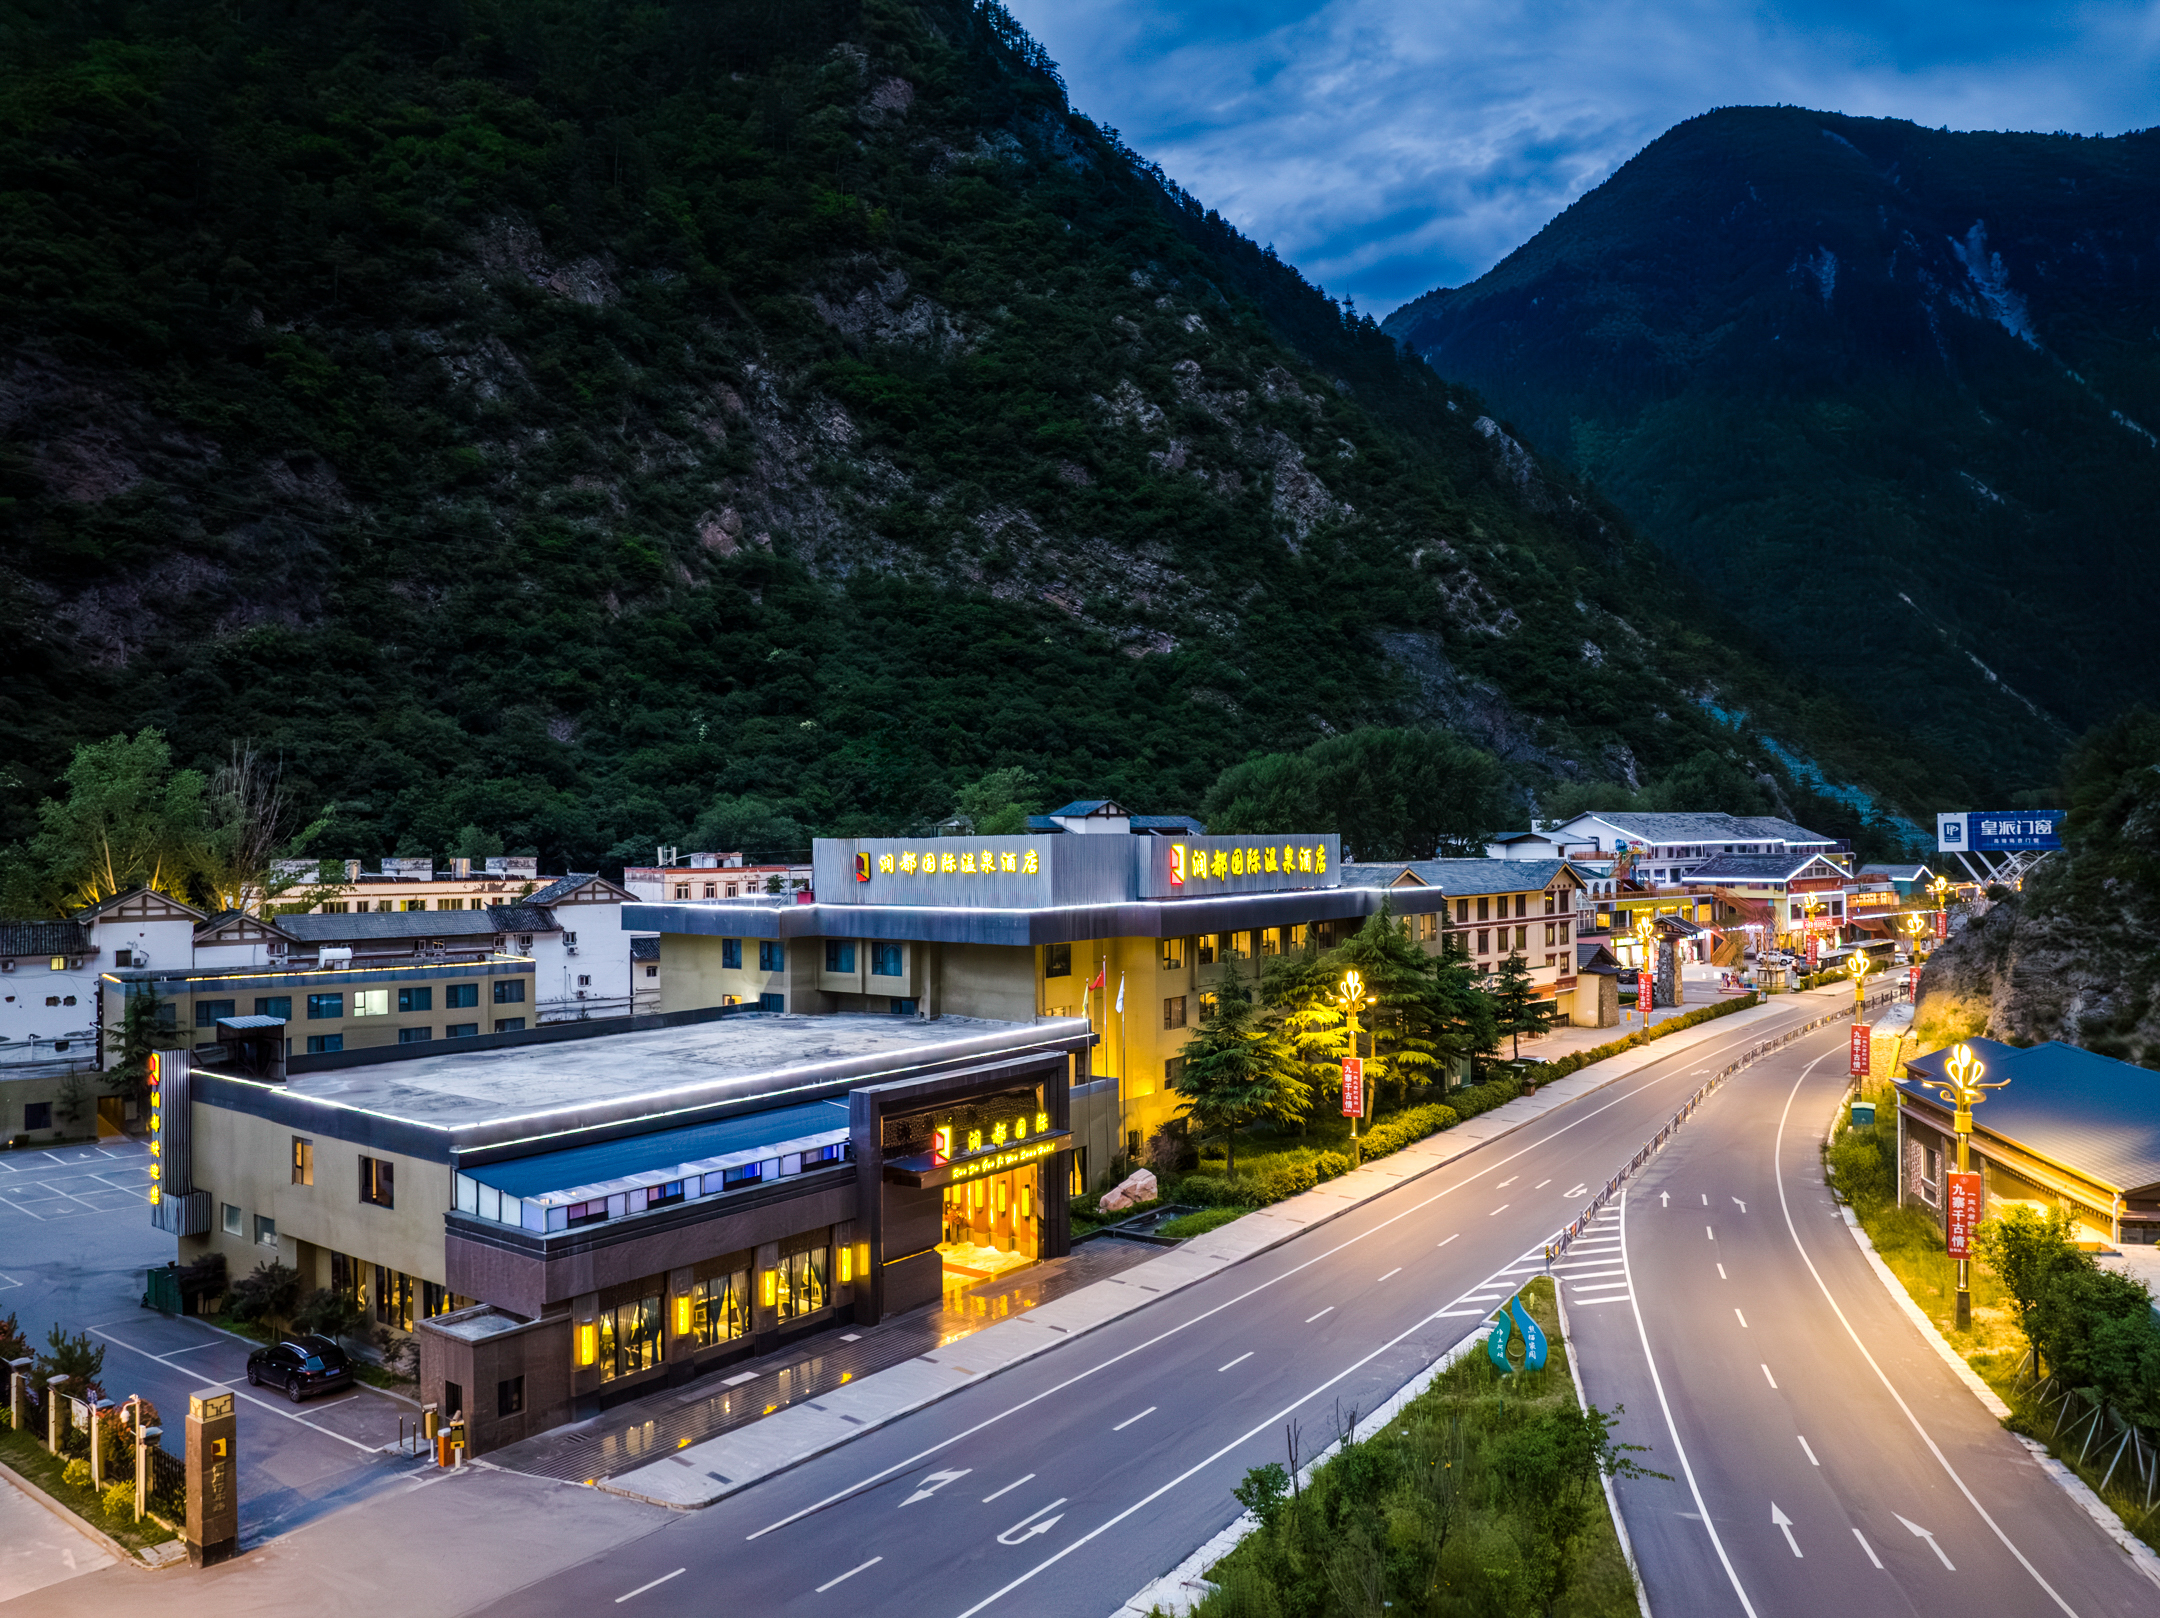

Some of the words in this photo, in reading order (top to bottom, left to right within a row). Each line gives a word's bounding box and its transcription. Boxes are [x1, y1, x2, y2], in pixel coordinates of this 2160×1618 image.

[1981, 819, 2052, 835] 皇派门窗
[879, 849, 1039, 875] 润都国际温泉酒店
[1191, 844, 1327, 881] 润都国际温泉酒店
[1853, 1031, 1861, 1068] 九寨千古情
[1344, 1065, 1353, 1109] 九寨千古情
[1952, 1183, 1965, 1248] 九寨千古情
[1527, 1325, 1537, 1360] 熊猫家园
